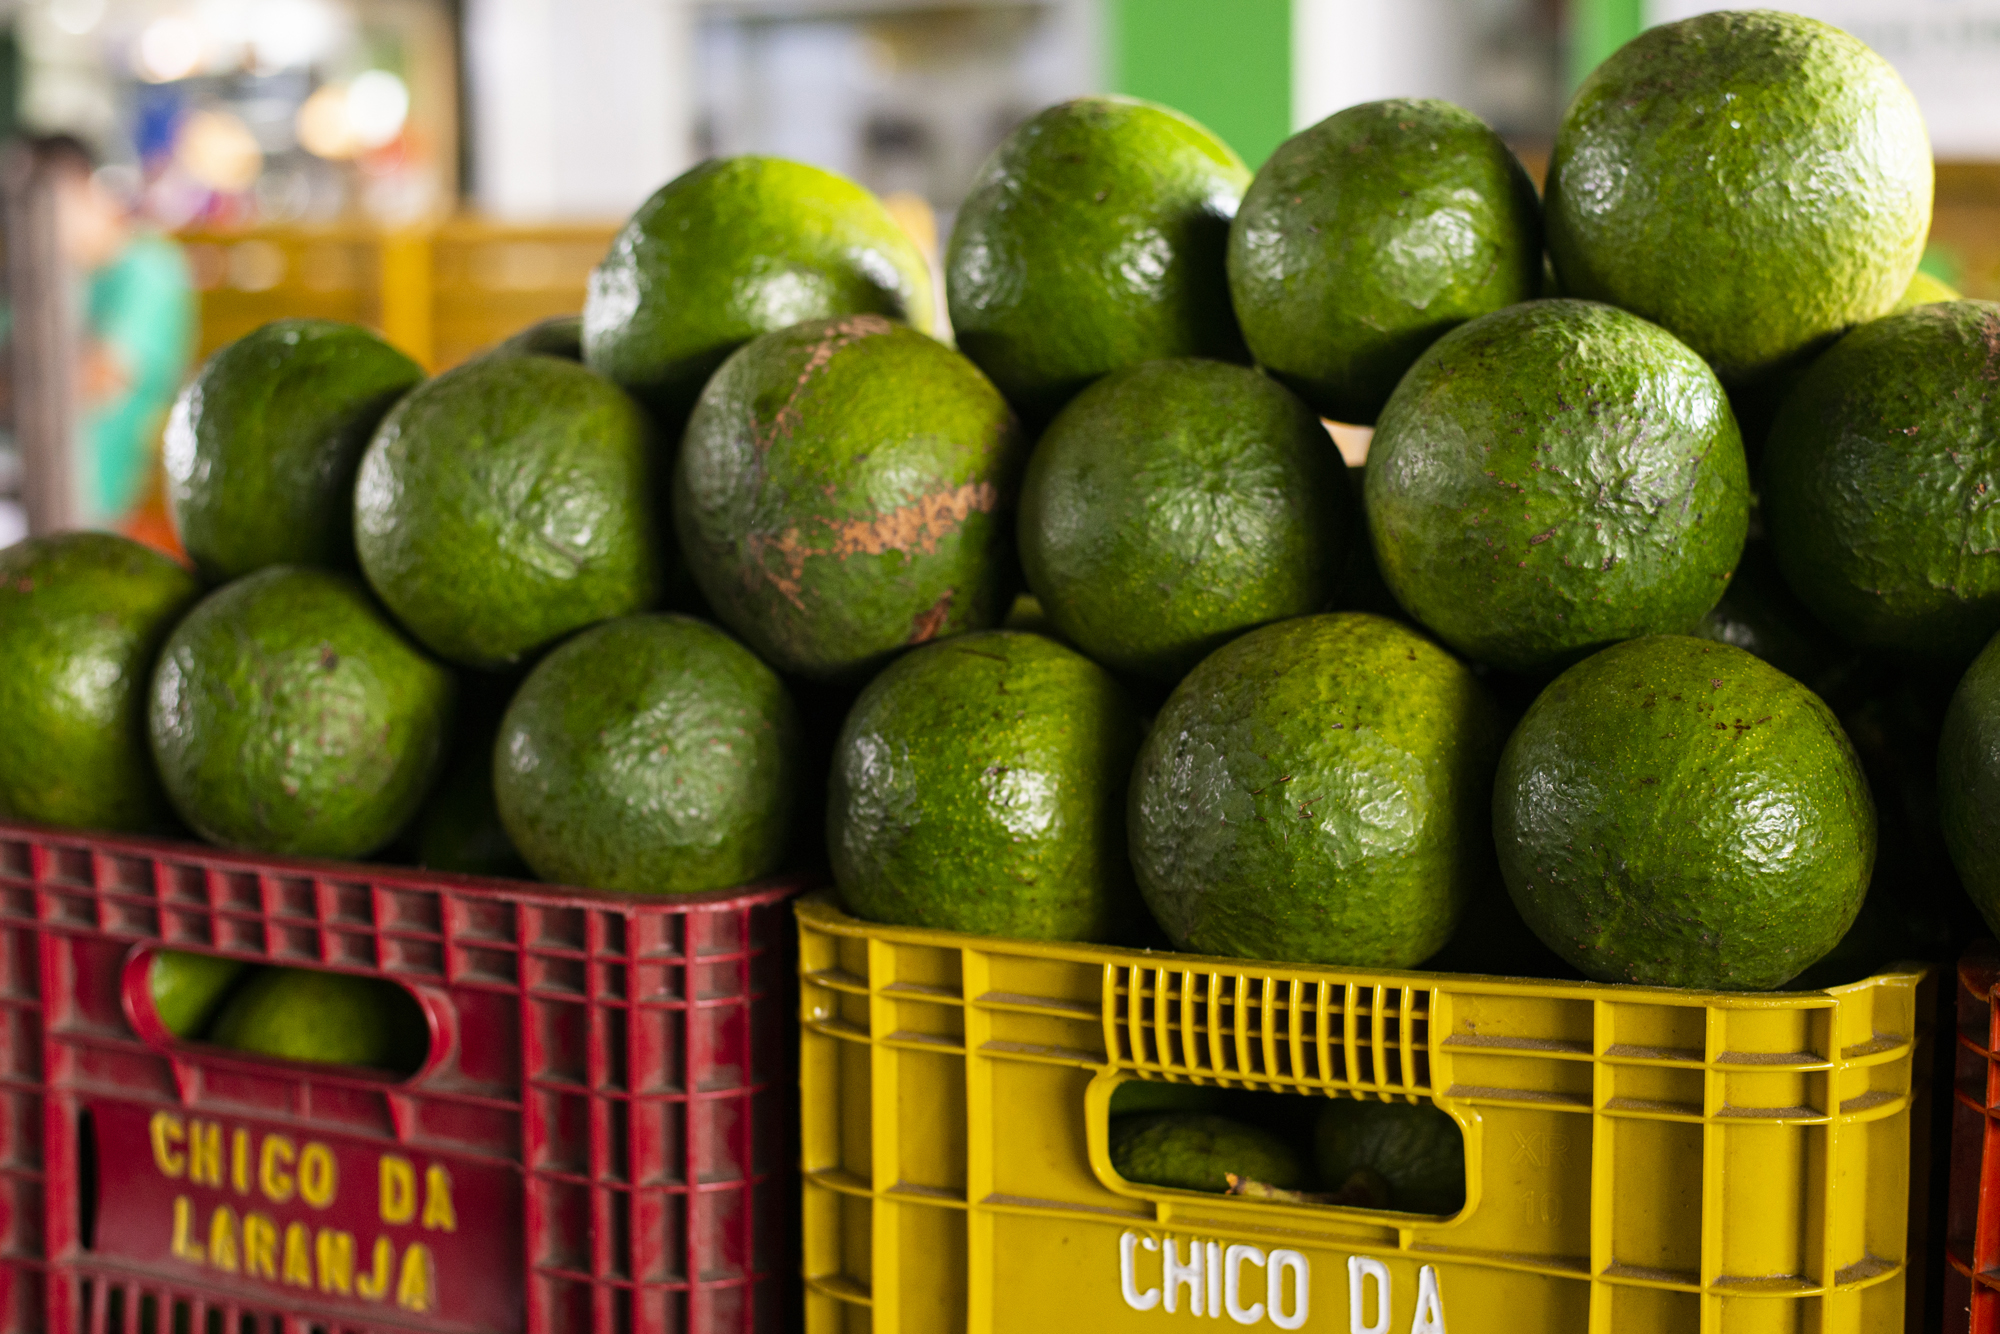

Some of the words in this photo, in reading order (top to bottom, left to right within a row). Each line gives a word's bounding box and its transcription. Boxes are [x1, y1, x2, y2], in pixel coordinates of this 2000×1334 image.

[149, 1110, 337, 1208] CHICO
[378, 1153, 457, 1232] DA
[171, 1194, 433, 1313] LARANJA
[1119, 1230, 1310, 1330] CHICO
[1347, 1255, 1446, 1334] DA
